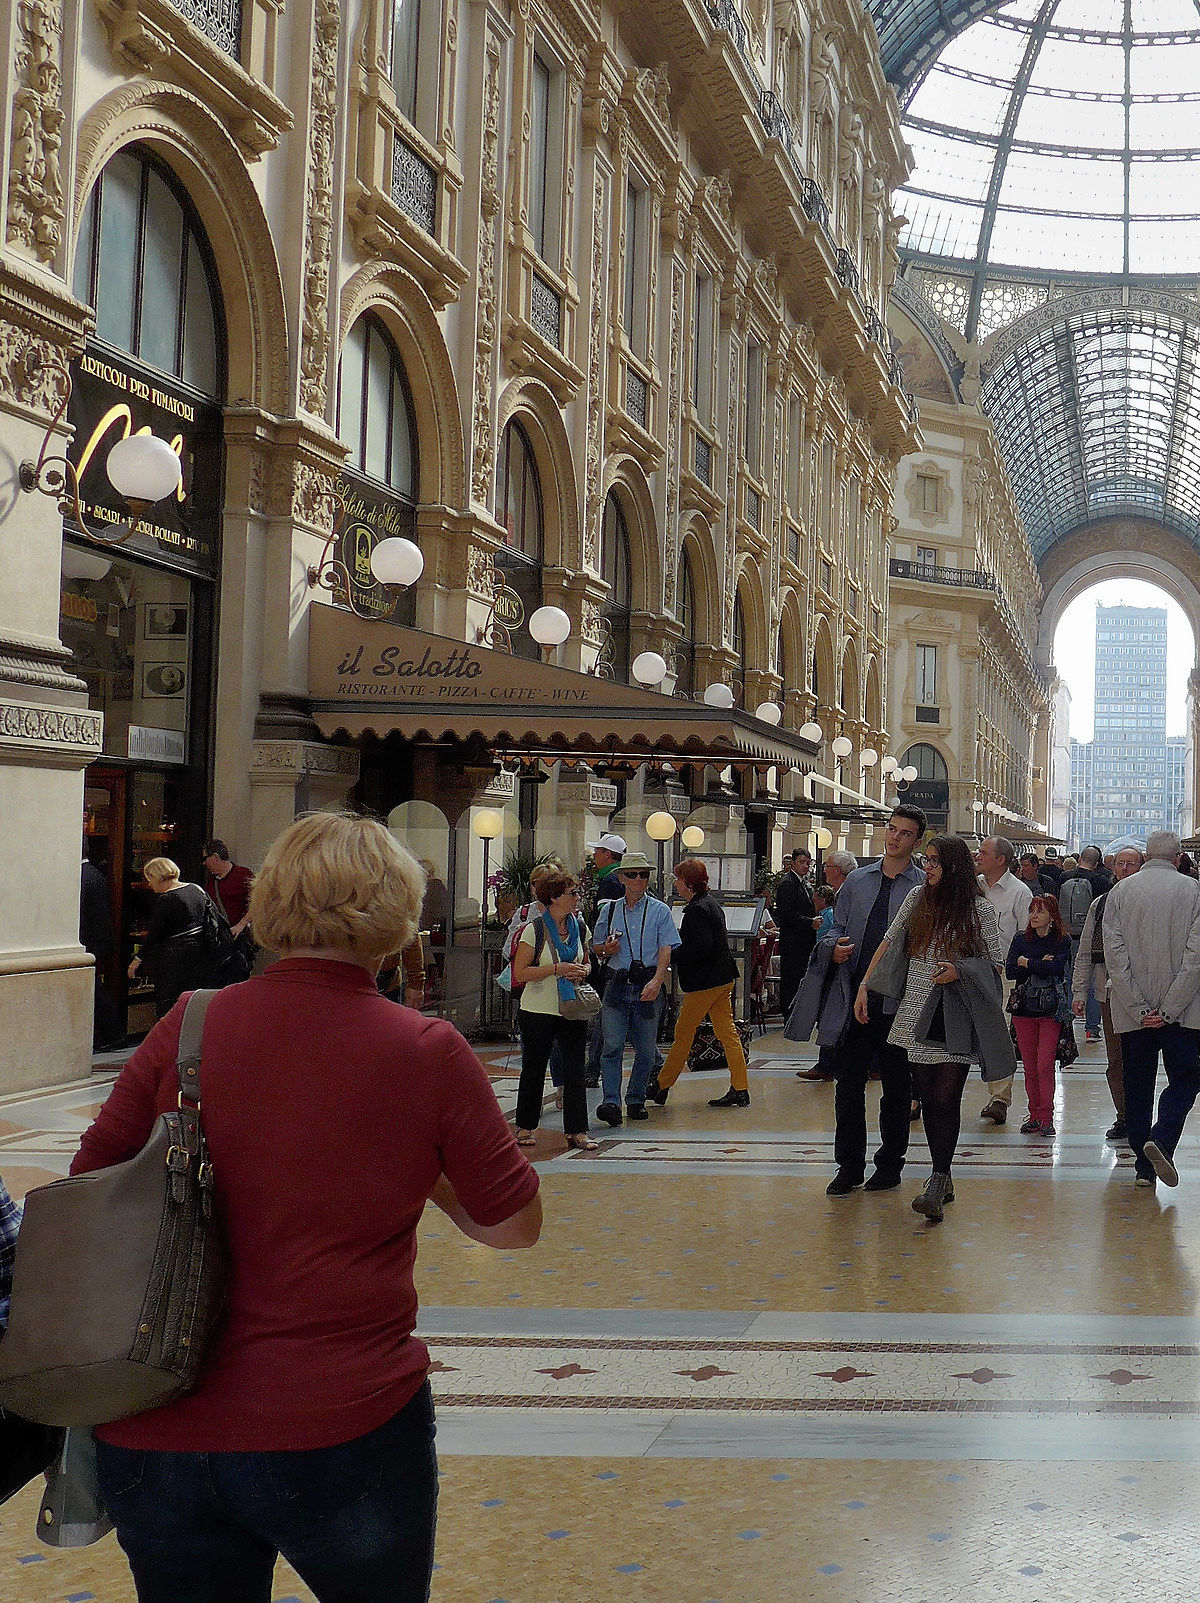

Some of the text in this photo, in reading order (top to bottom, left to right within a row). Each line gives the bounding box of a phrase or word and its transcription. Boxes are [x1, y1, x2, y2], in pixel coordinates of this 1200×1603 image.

[80, 354, 195, 422] ARTICOLI PER FUMATORI
[93, 504, 120, 525] SIGARI
[155, 525, 181, 546] BOLLATI
[337, 644, 484, 679] il Salotto
[337, 683, 426, 697] RISTORANTE
[438, 685, 479, 698] PIZZA
[552, 689, 592, 701] WINE
